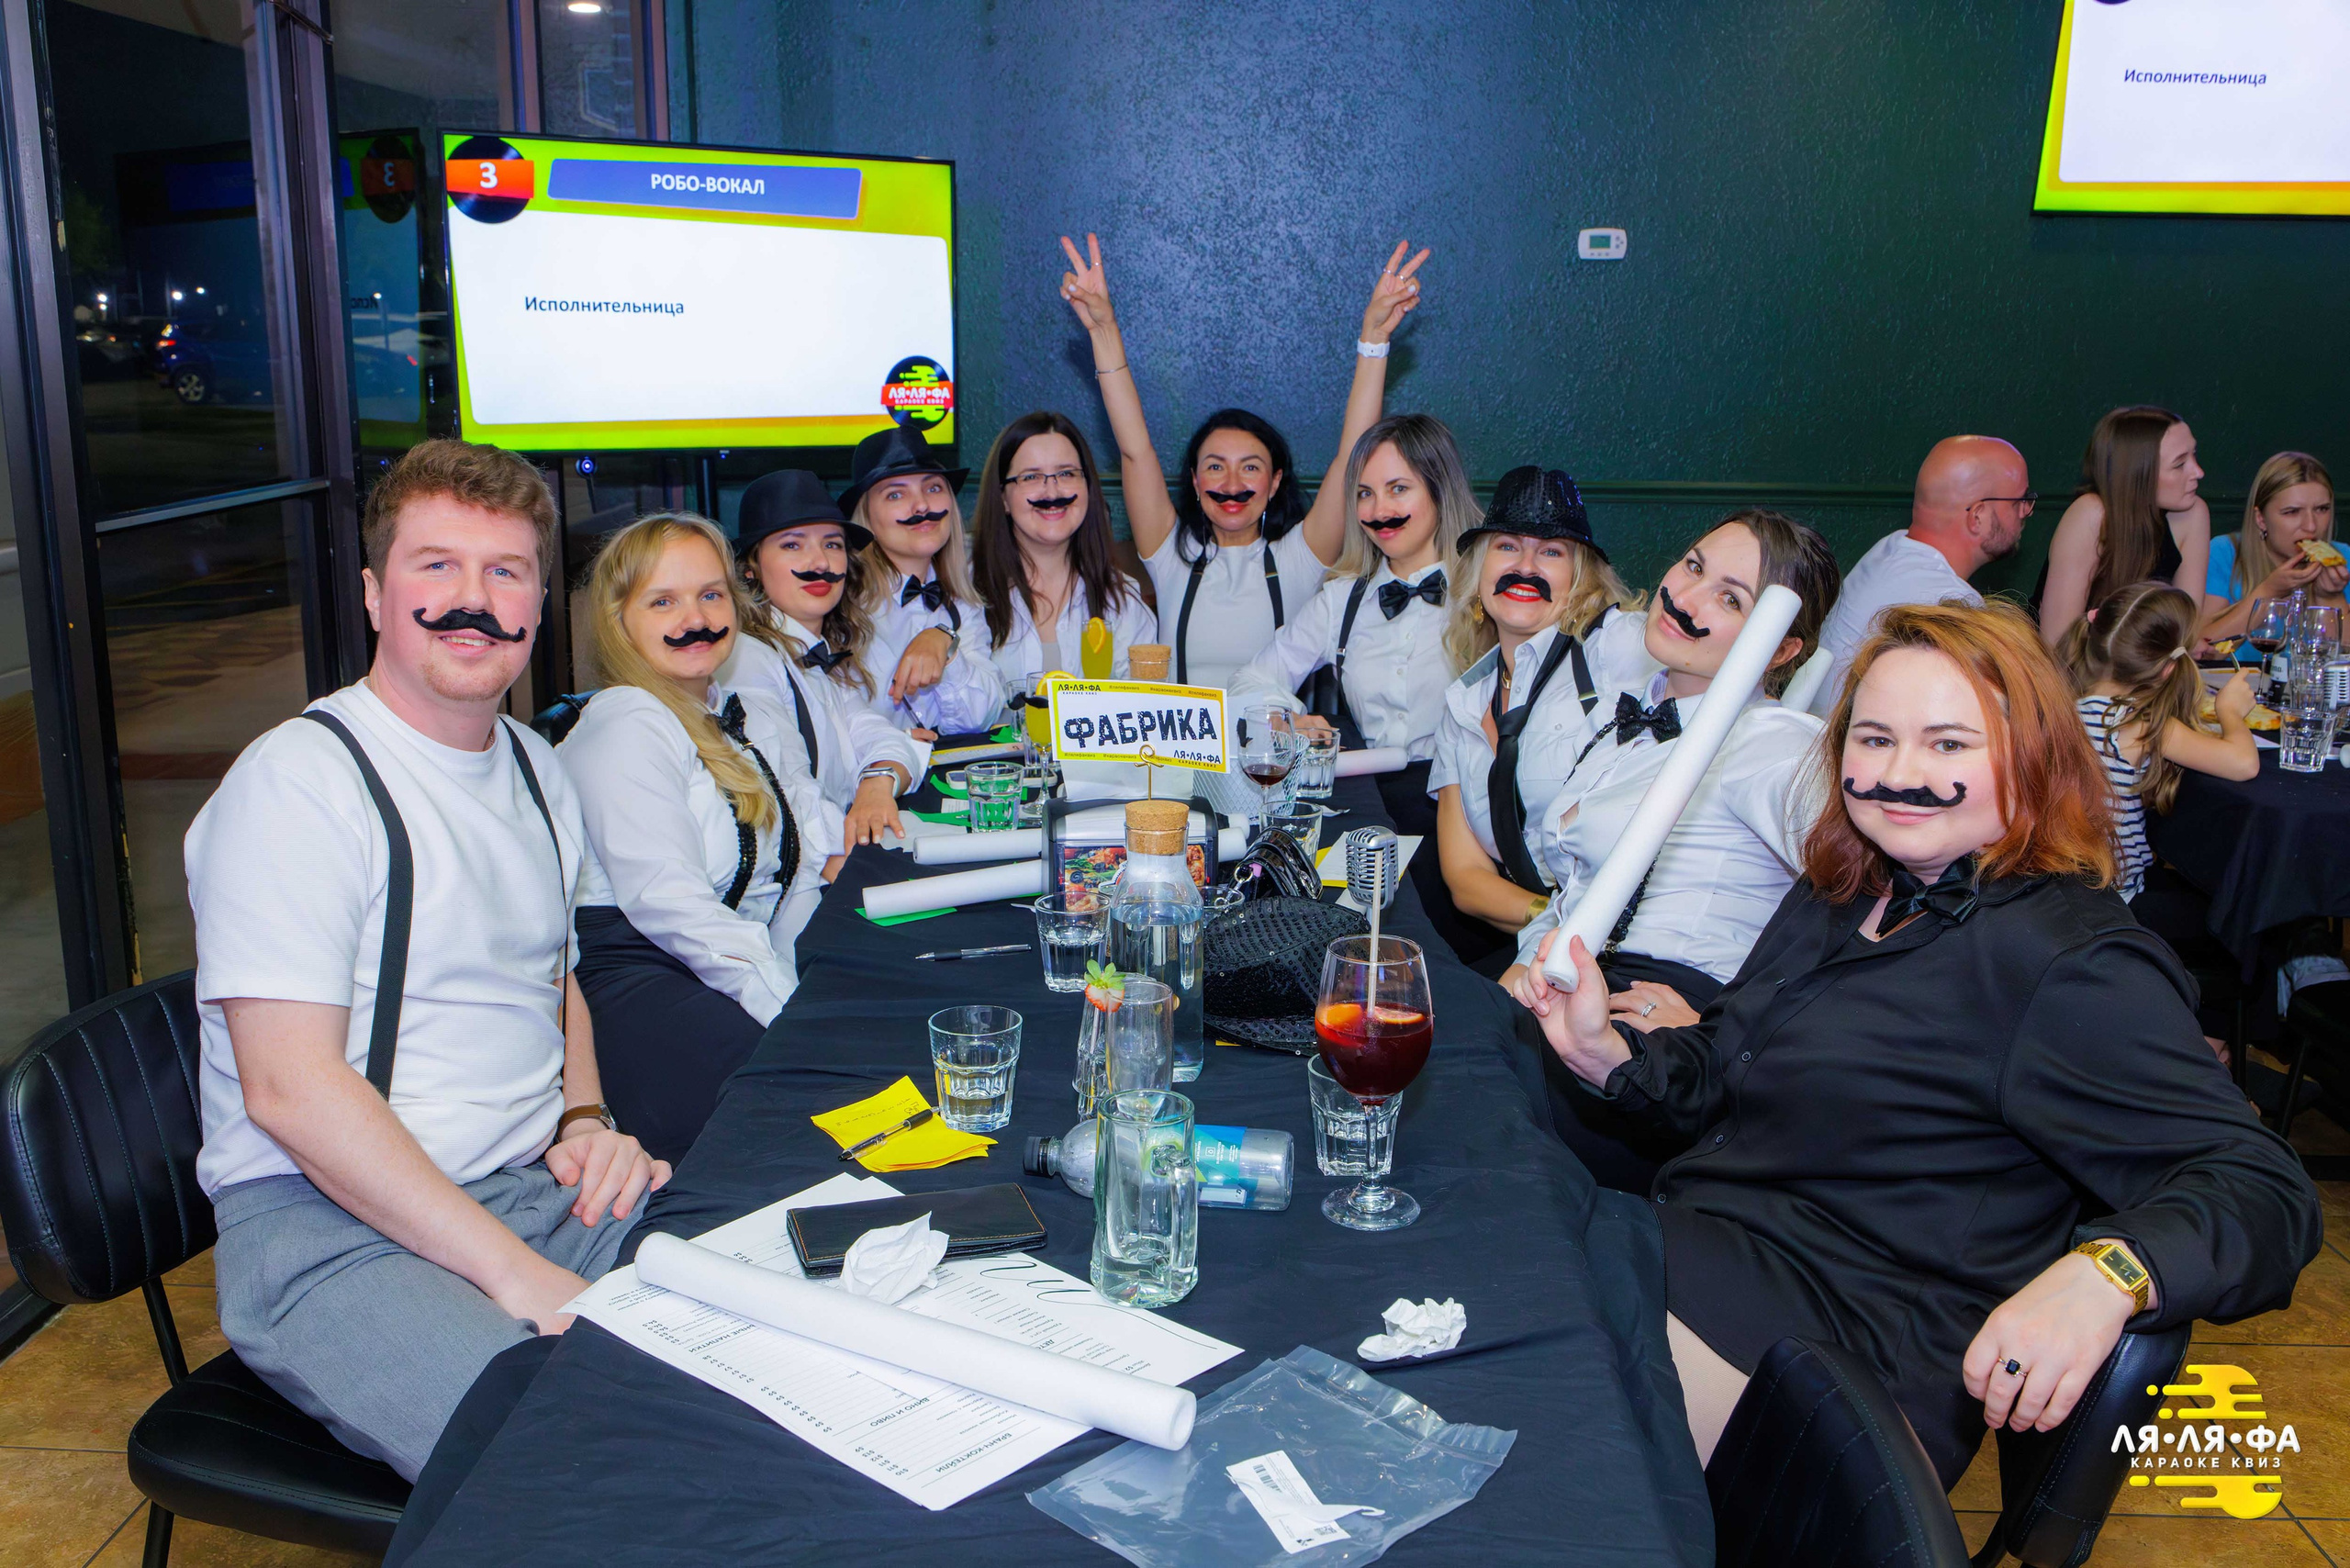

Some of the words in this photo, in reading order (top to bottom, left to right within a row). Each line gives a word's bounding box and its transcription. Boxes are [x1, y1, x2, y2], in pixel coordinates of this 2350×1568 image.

[2123, 69, 2267, 86] Исполнительница
[478, 162, 498, 189] 3
[650, 173, 766, 196] РОБО-ВОКАЛ
[524, 296, 685, 316] Исполнительница
[1063, 707, 1218, 748] ФАБРИКА
[904, 1396, 930, 1412] ВИНО
[869, 1414, 896, 1428] ПИВО
[935, 1432, 1013, 1473] БРАНЧ-КОКТЕЙЛИ
